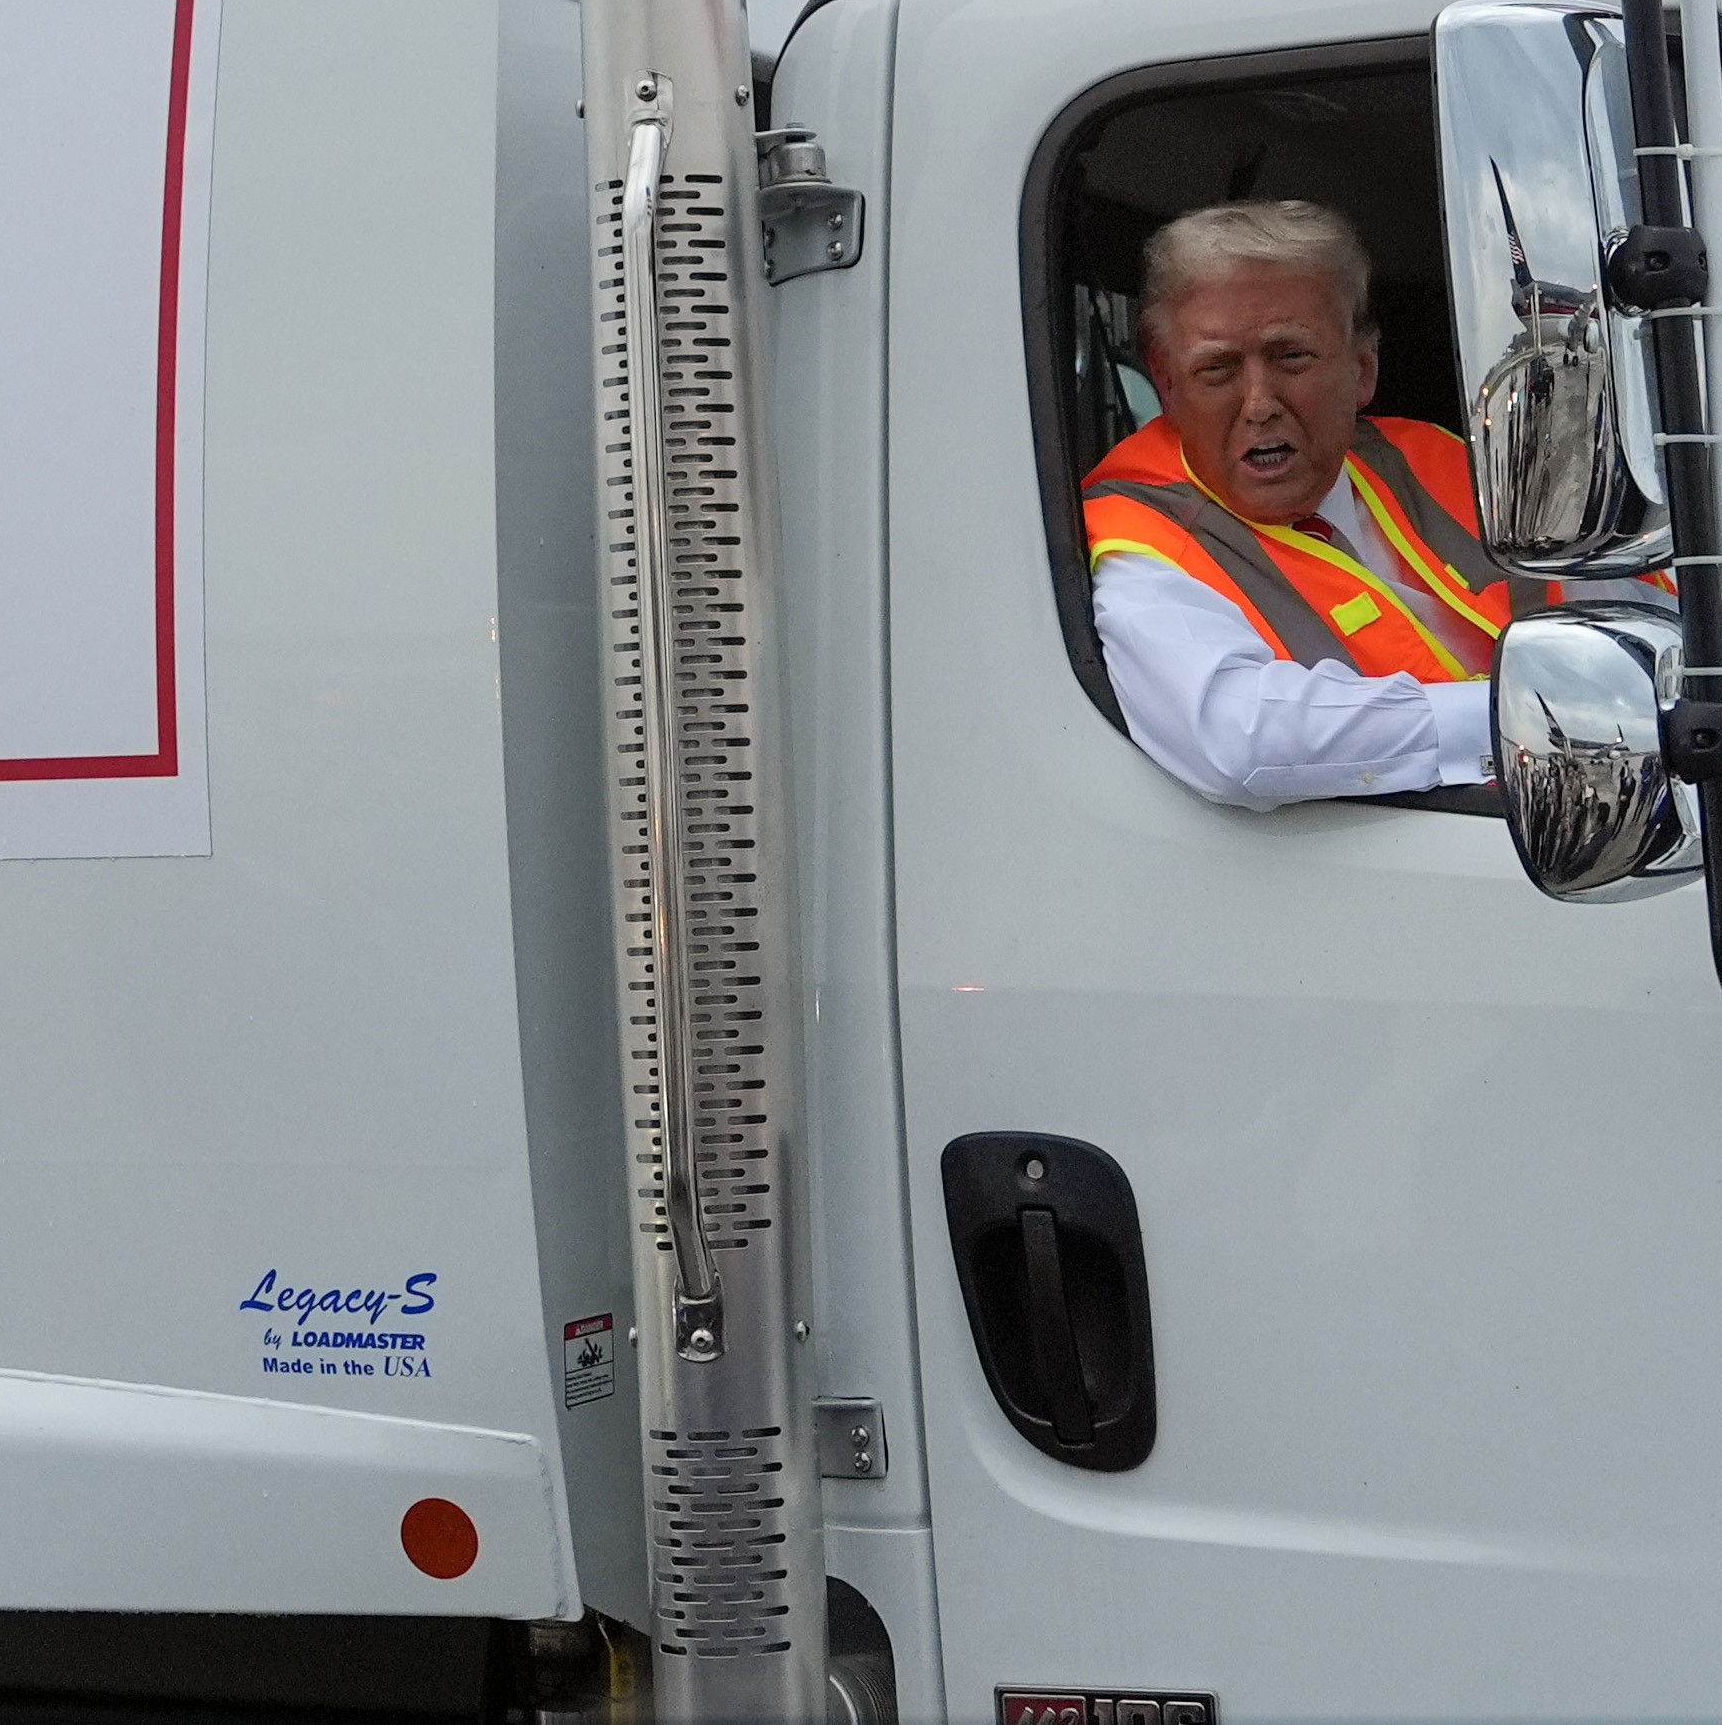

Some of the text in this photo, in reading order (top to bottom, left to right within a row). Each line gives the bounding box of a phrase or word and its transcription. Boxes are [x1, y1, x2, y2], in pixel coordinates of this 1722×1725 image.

[239, 1268, 437, 1326] Legacy-S
[263, 1327, 426, 1351] by LOADMASTER
[263, 1355, 432, 1377] Made in the USA
